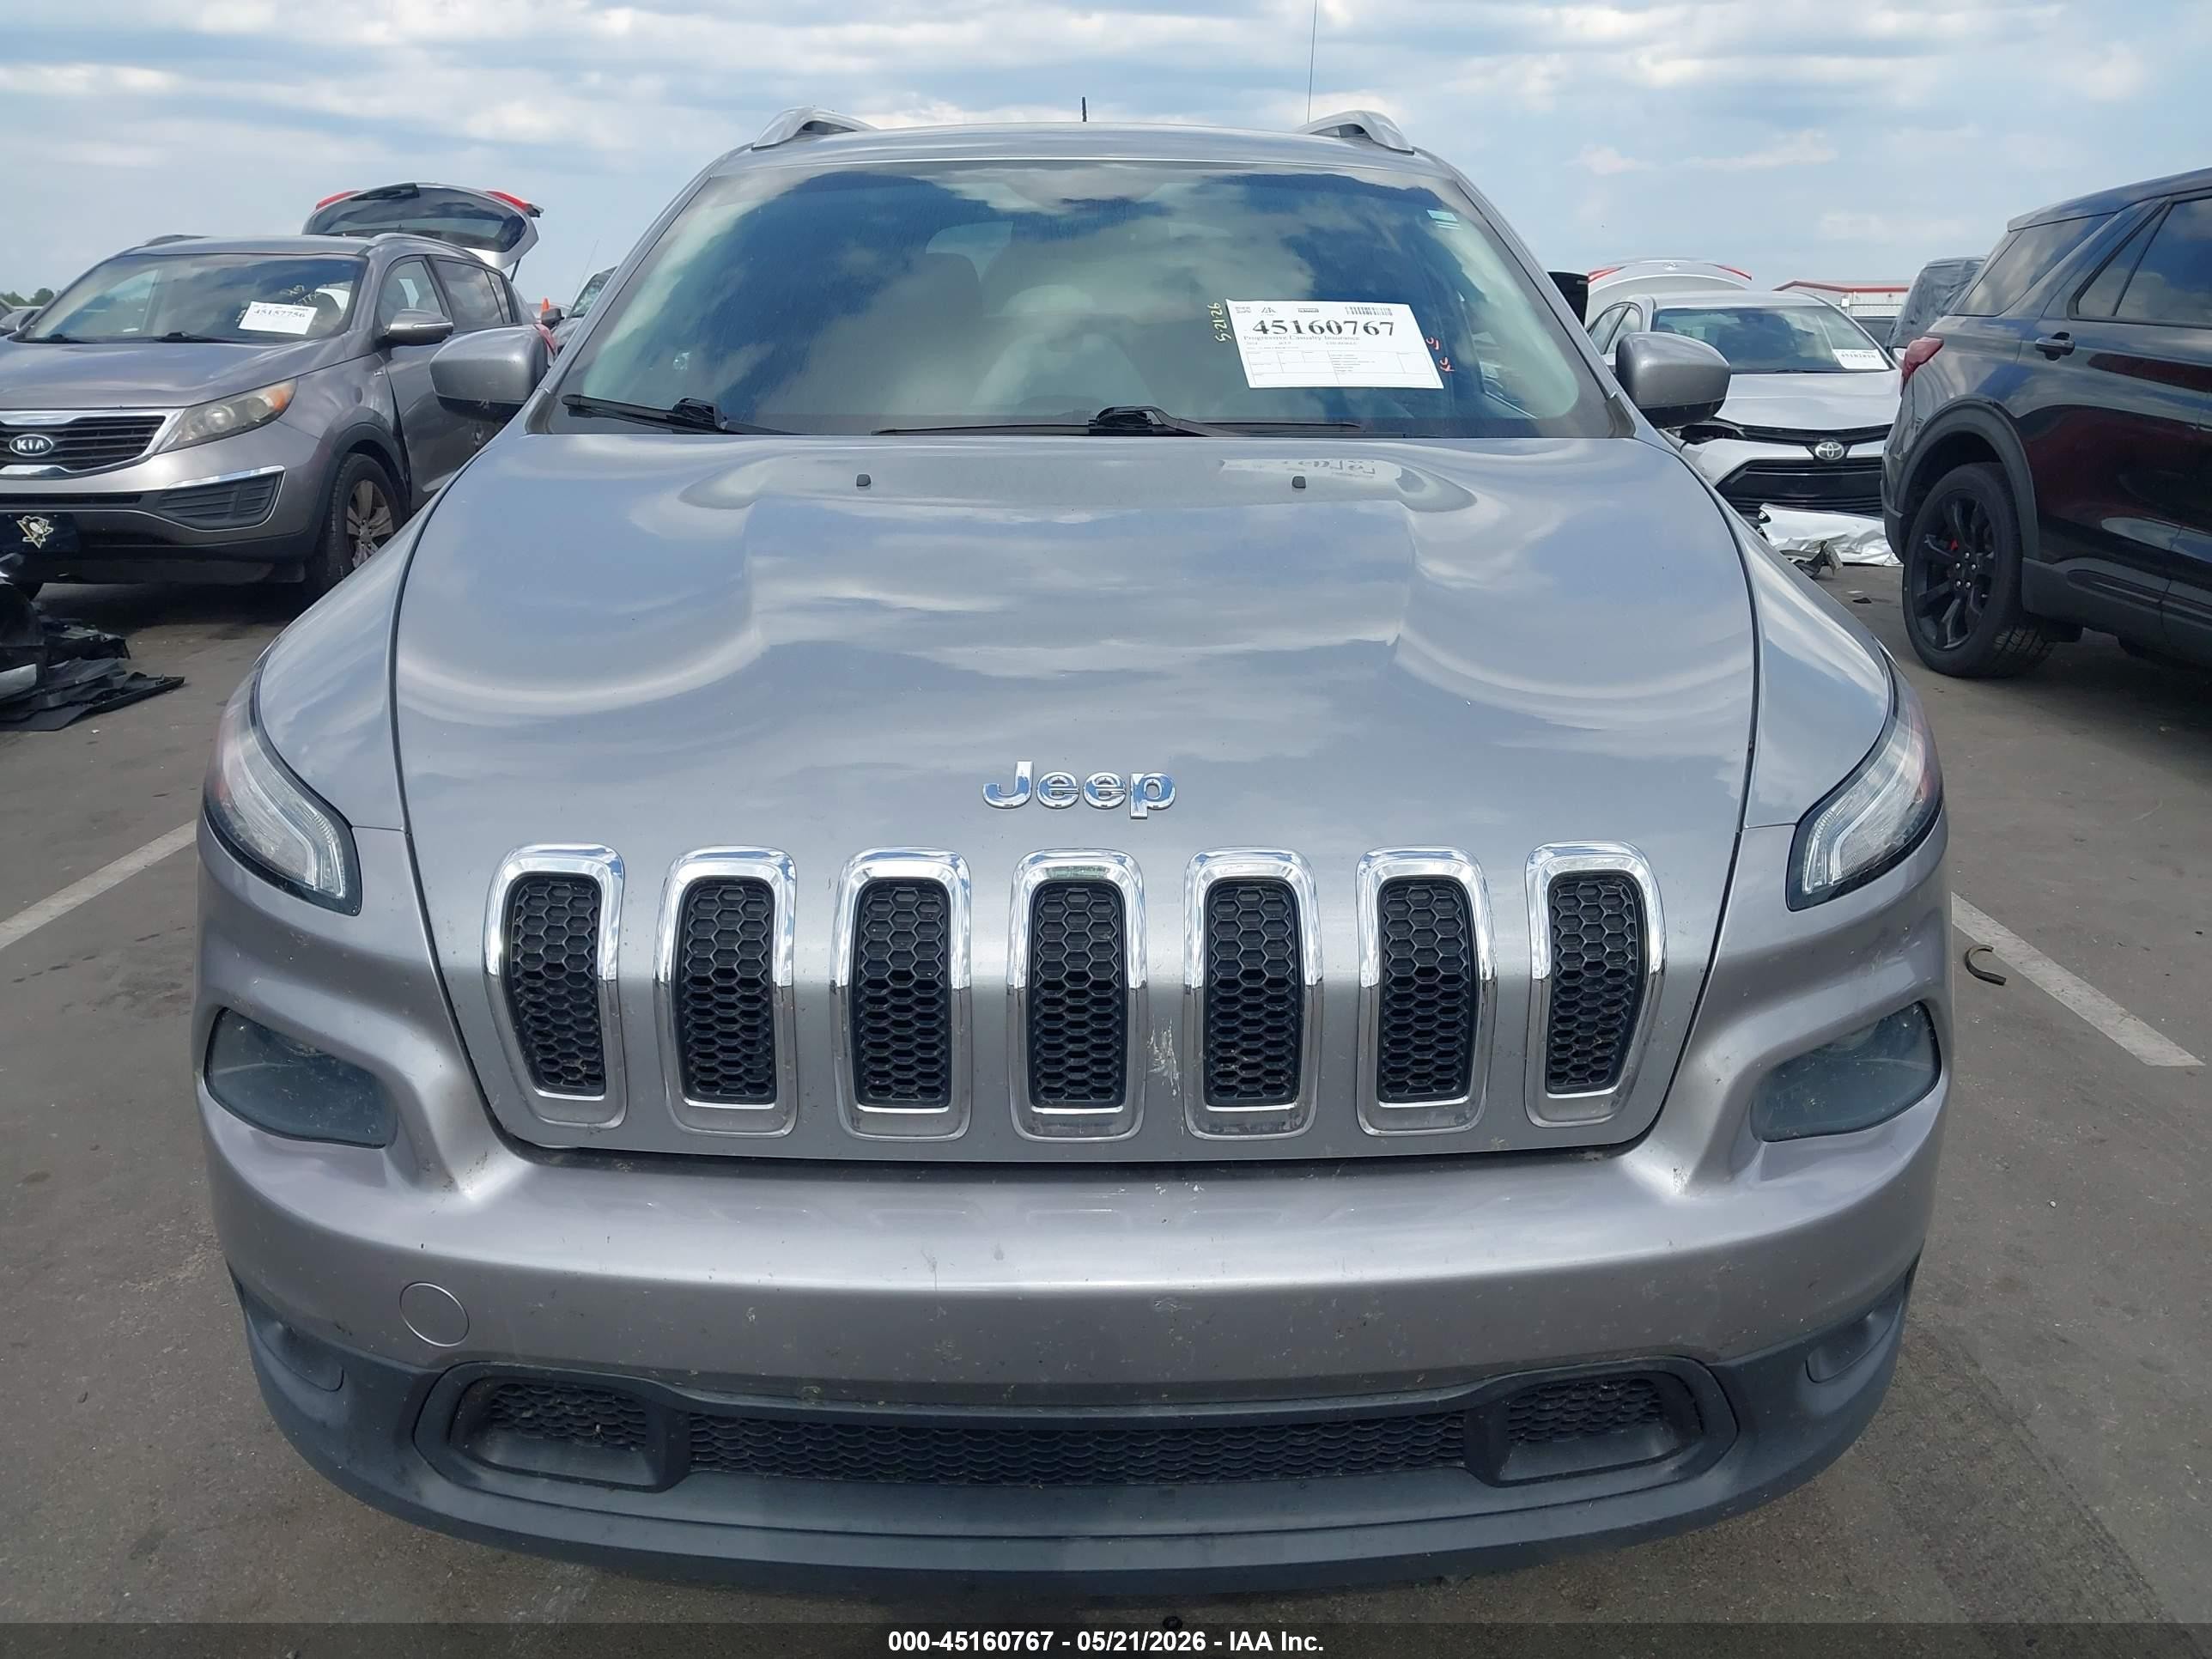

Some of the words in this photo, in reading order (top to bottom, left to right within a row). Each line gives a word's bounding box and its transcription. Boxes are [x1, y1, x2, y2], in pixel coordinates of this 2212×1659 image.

[1252, 319, 1394, 336] 45160767
[16, 439, 45, 450] KIA
[982, 761, 1176, 819] Jeep
